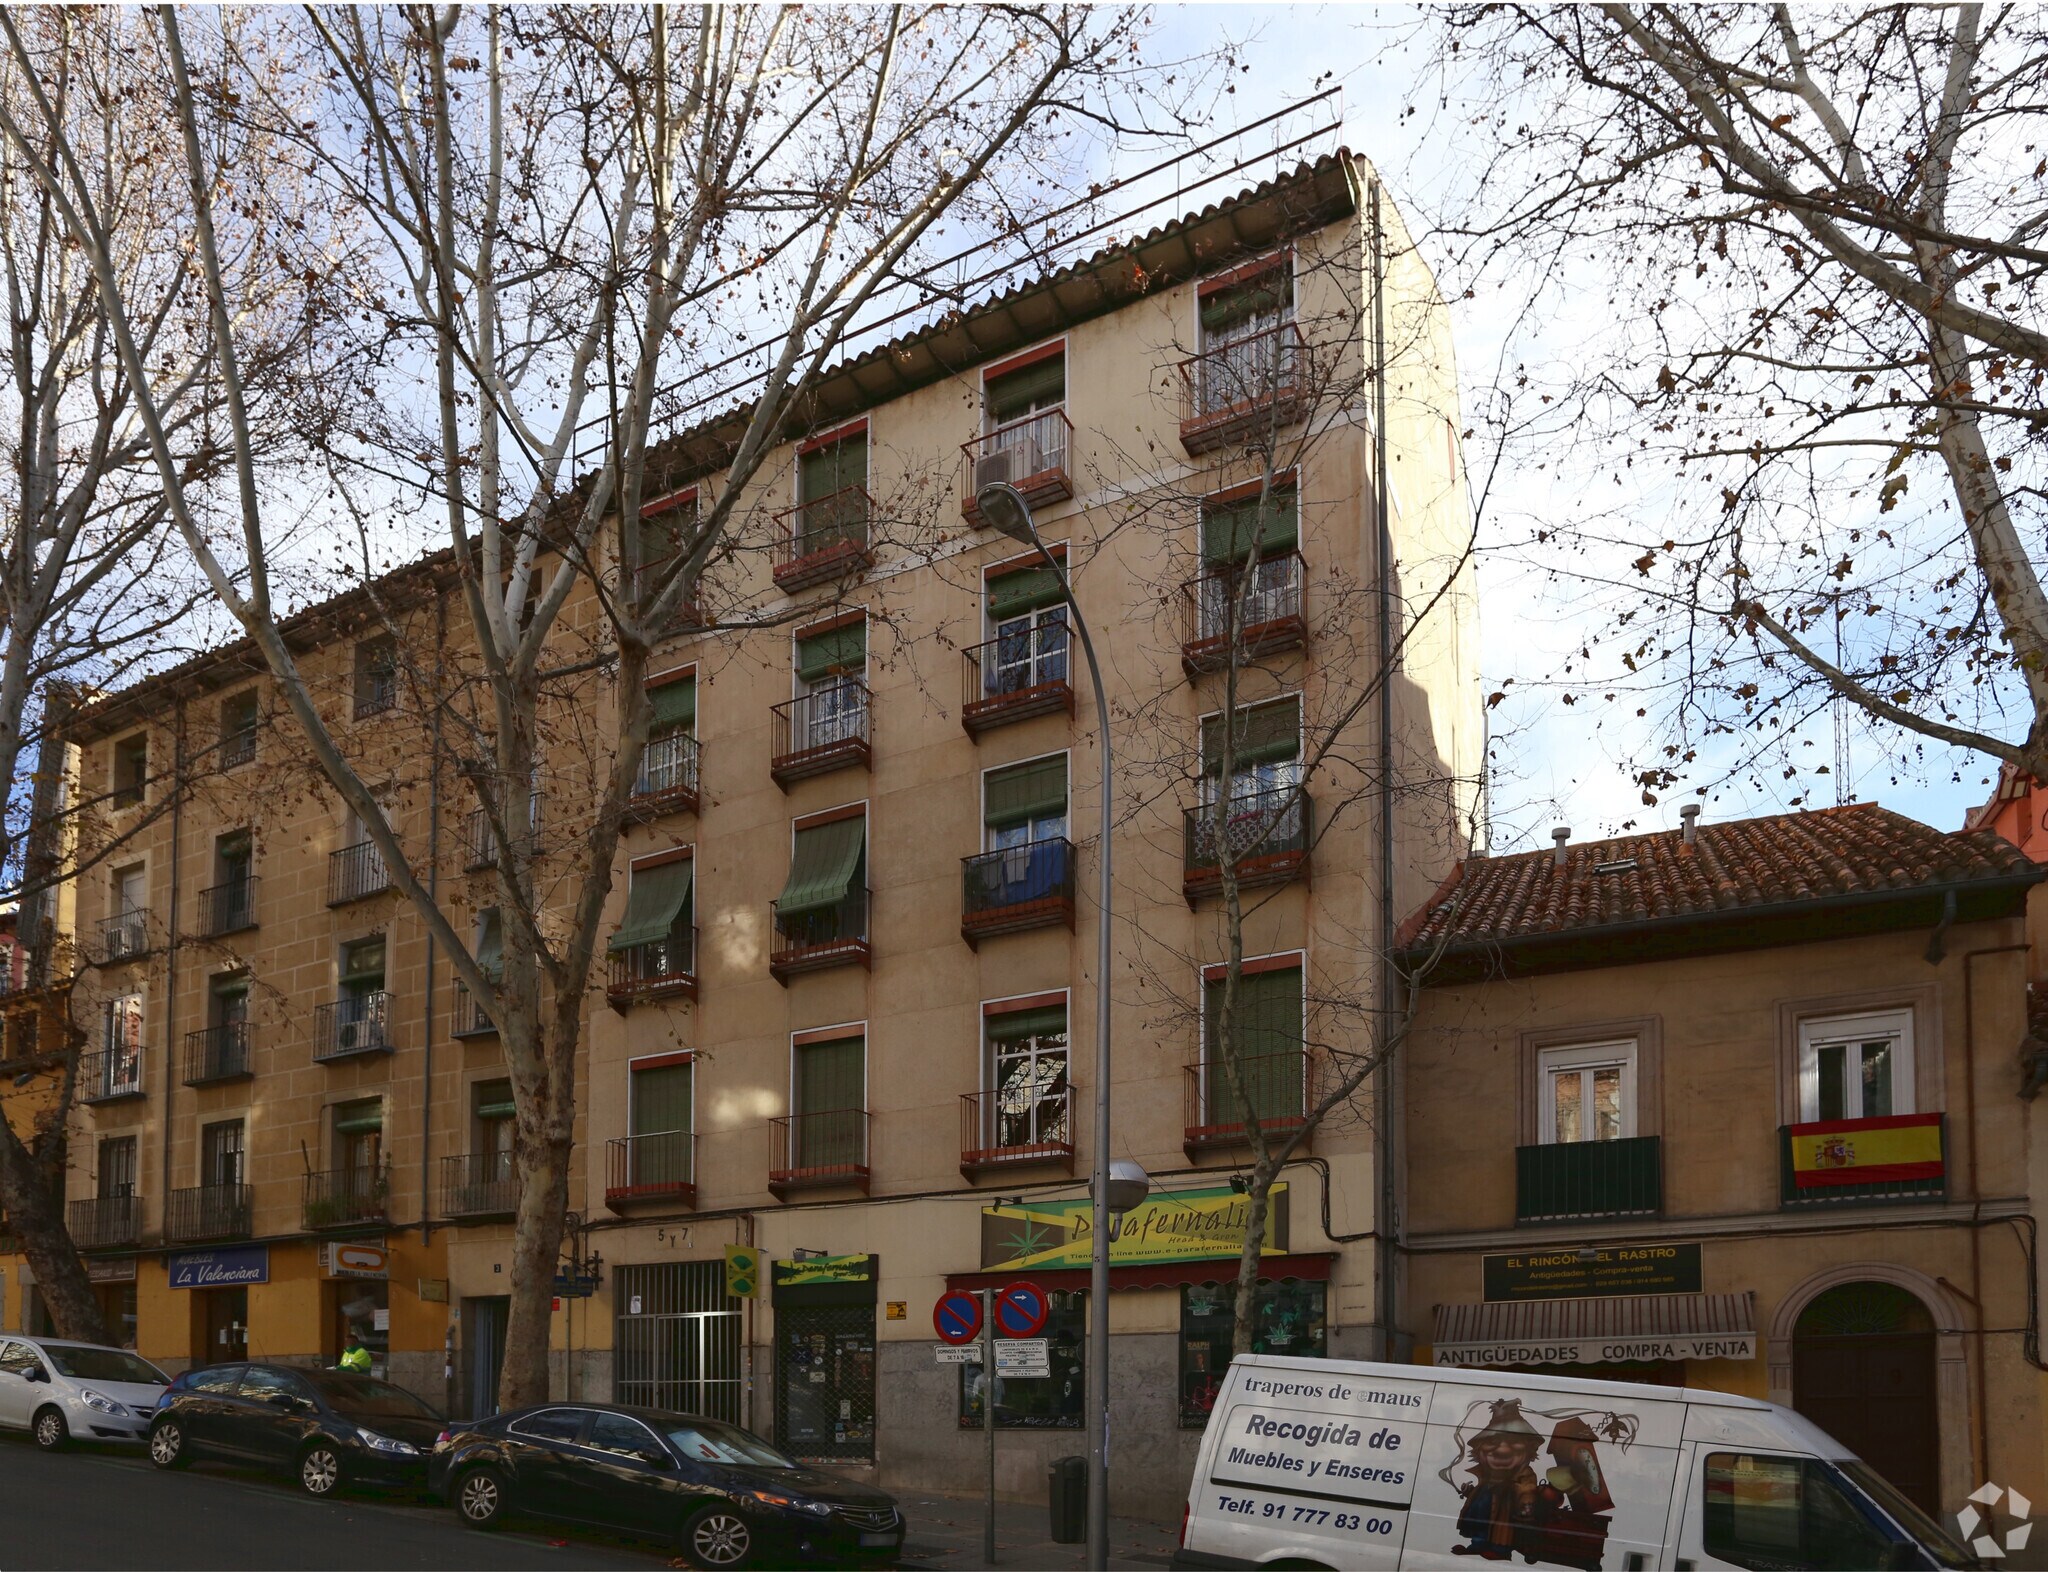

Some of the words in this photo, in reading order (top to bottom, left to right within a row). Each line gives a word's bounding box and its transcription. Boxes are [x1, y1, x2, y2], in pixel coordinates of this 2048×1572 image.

[1071, 1201, 1251, 1243] Pafernali
[657, 1229, 665, 1242] 5
[682, 1227, 689, 1241] 7
[1168, 1234, 1195, 1244] Head
[1070, 1252, 1093, 1260] Tiend
[1507, 1258, 1523, 1268] EL
[1597, 1251, 1613, 1262] EL
[1619, 1247, 1677, 1261] RASTRO
[176, 1265, 192, 1284] La
[197, 1262, 260, 1283] Valenciana
[1529, 1269, 1586, 1280] Antigüedades
[1593, 1264, 1654, 1277] Compra-venta
[1438, 1346, 1579, 1364] ANTIGÜEDADES
[1602, 1344, 1673, 1359] COMPRA
[1692, 1341, 1749, 1356] VENTA
[1245, 1377, 1323, 1398] traperos
[1328, 1384, 1351, 1400] de
[1245, 1414, 1361, 1447] Recogida
[1368, 1428, 1401, 1450] de
[1227, 1447, 1304, 1472] Muebles
[1307, 1460, 1321, 1477] y
[1325, 1459, 1405, 1485] Enseres
[1218, 1496, 1255, 1515] Telf.
[1262, 1503, 1286, 1519] 91
[1292, 1507, 1330, 1525] 777
[1334, 1513, 1360, 1530] 83
[1366, 1518, 1393, 1535] 00
